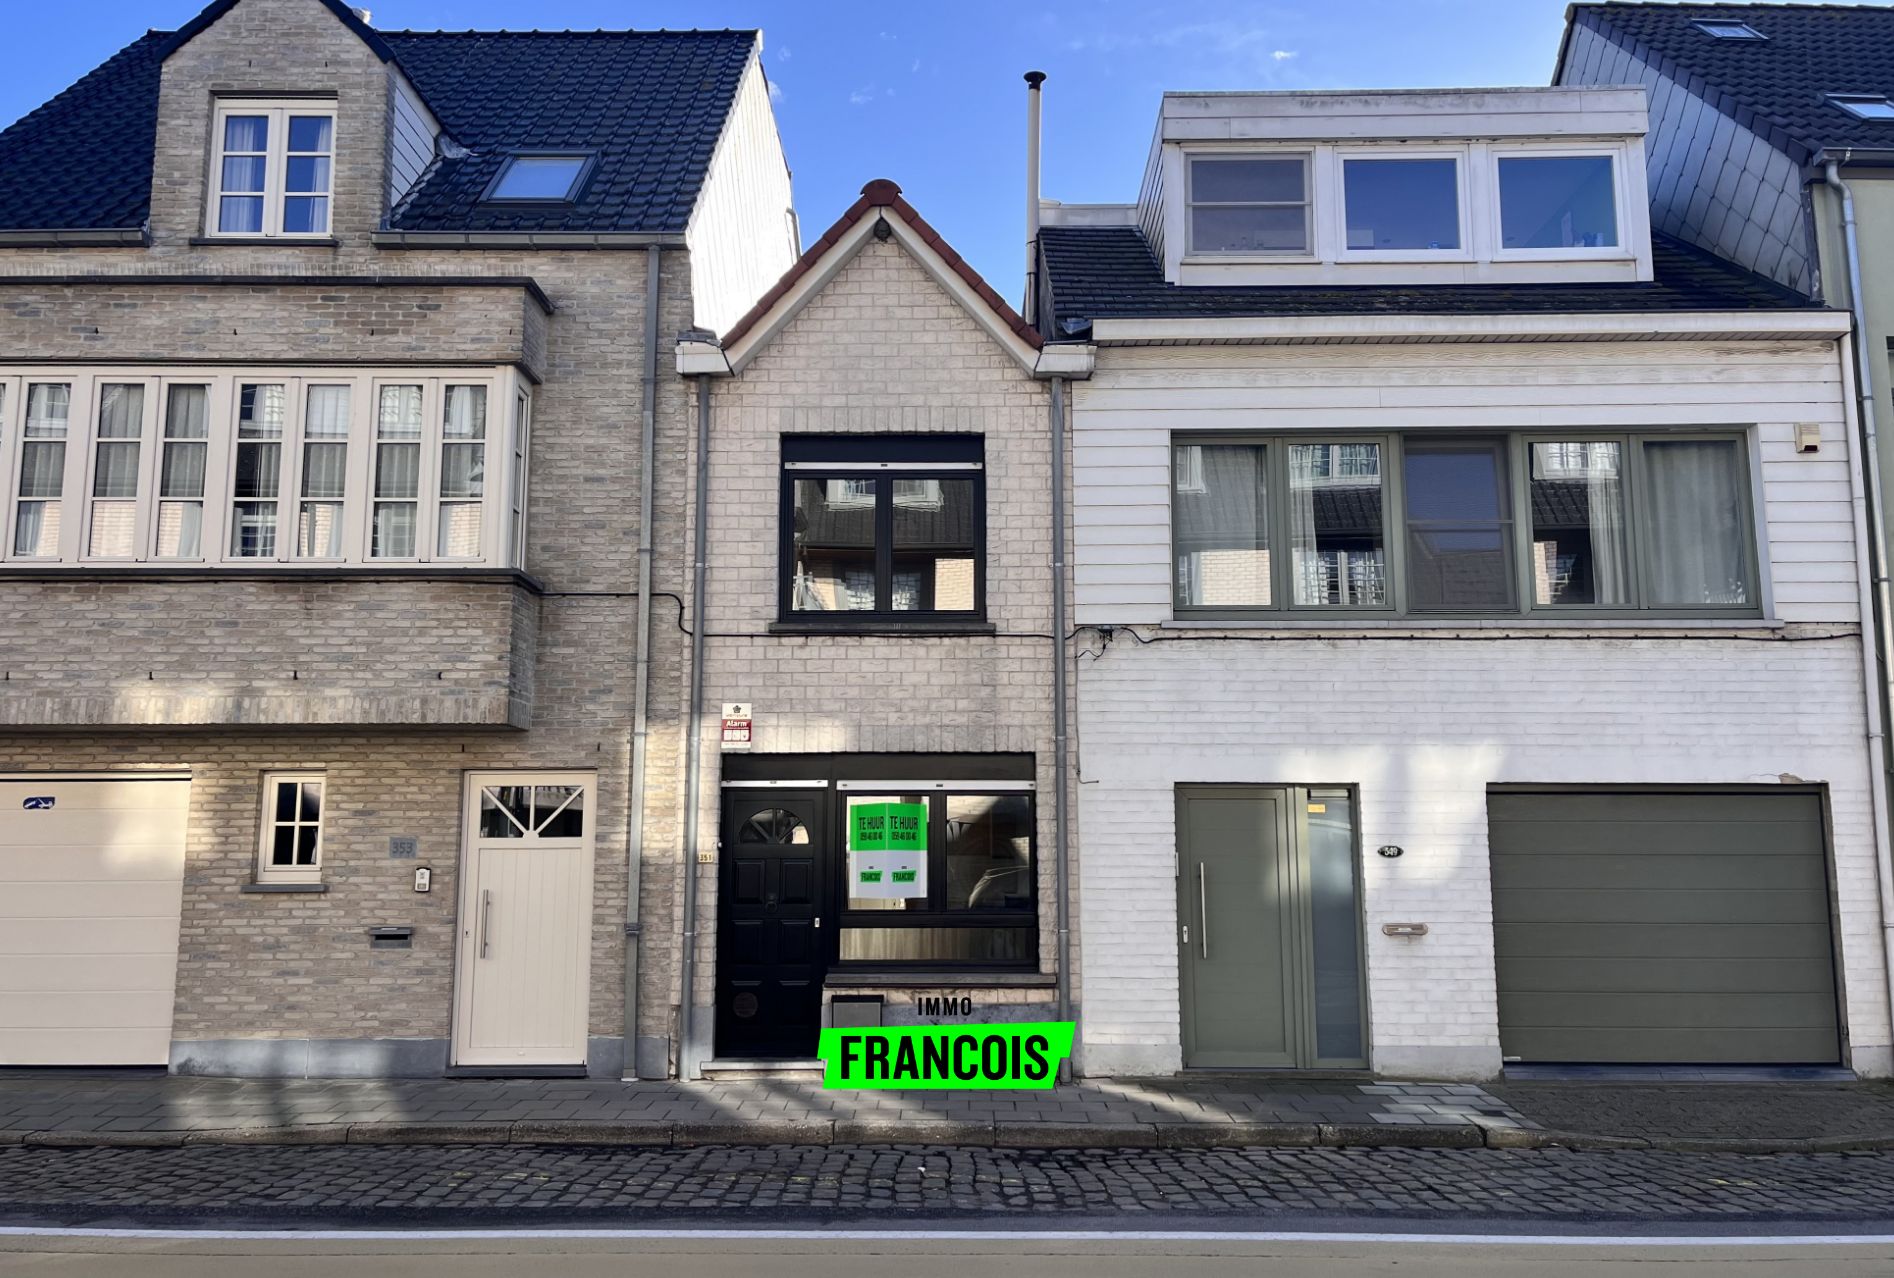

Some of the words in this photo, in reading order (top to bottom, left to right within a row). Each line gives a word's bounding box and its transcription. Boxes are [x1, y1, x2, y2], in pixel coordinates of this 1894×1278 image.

[726, 719, 747, 727] Alarm
[859, 817, 866, 830] TE
[868, 816, 884, 830] HUUR
[890, 816, 898, 829] TE
[899, 816, 918, 830] HUUR
[392, 842, 413, 854] 353
